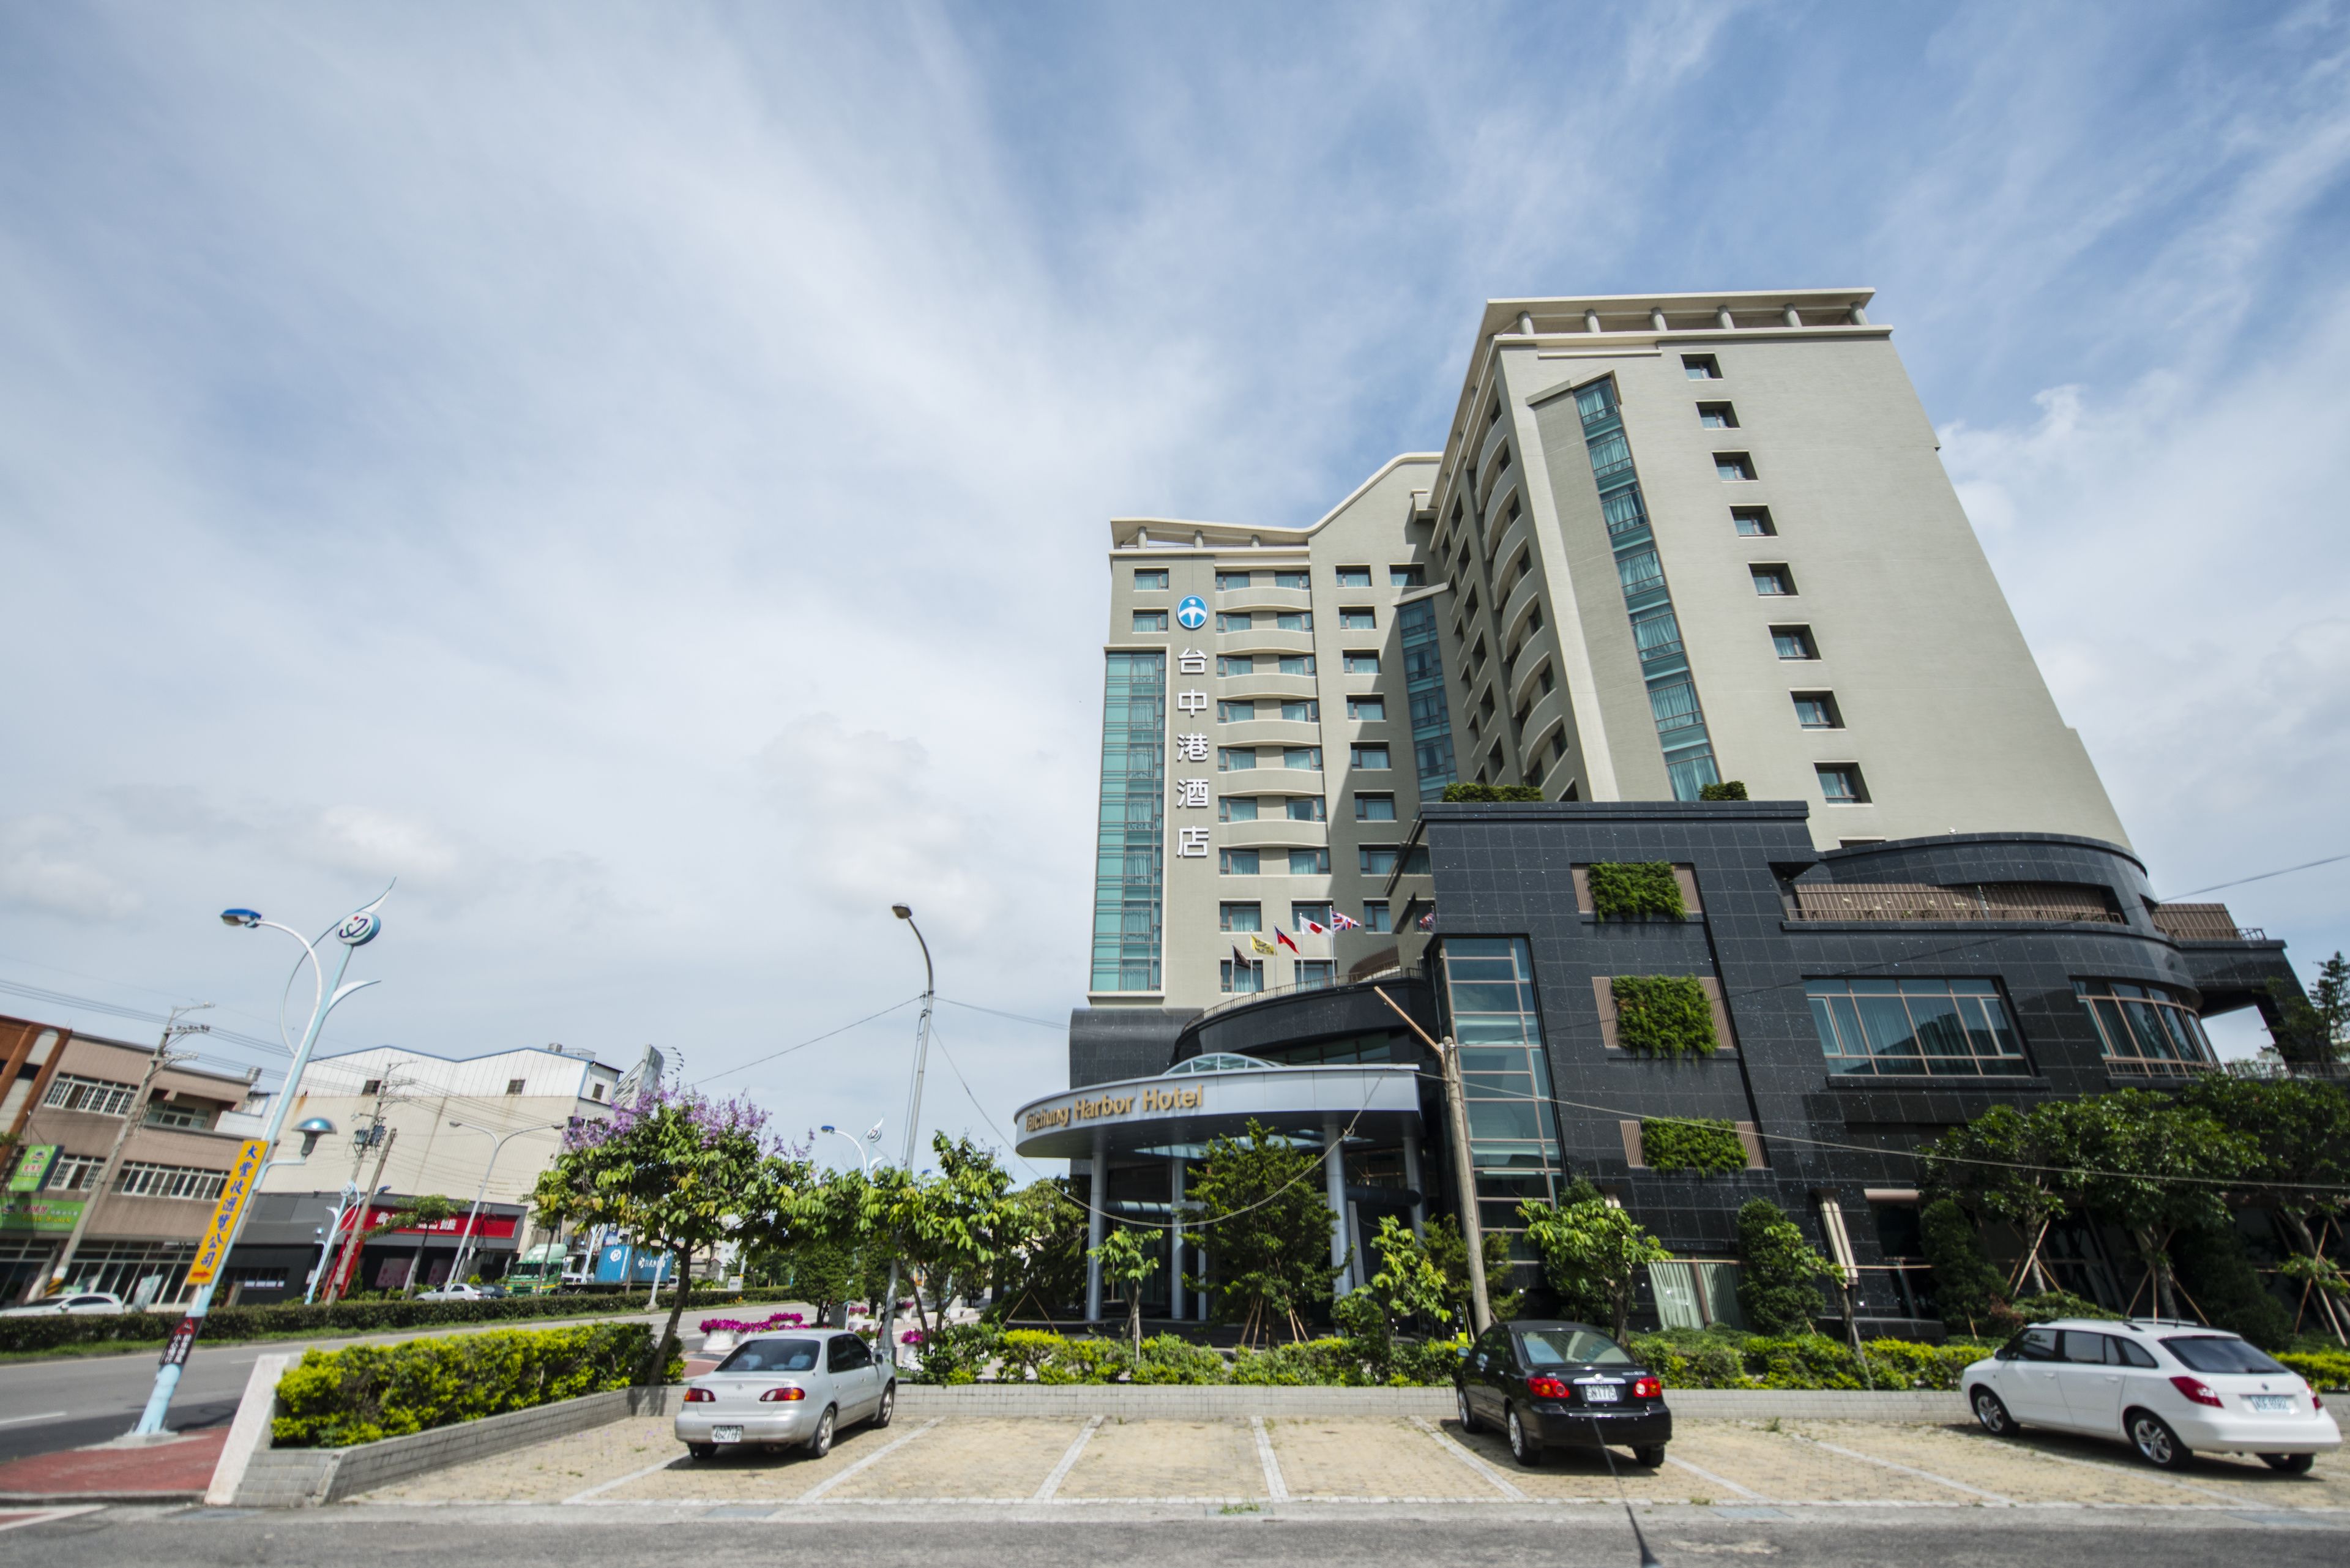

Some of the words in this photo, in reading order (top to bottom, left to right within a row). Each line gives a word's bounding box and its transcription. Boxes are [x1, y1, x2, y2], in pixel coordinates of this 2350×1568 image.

[1176, 648, 1209, 858] 台中港酒店
[1024, 1106, 1070, 1132] Taichung
[1073, 1095, 1135, 1121] Harbor
[1142, 1084, 1204, 1112] Hotel
